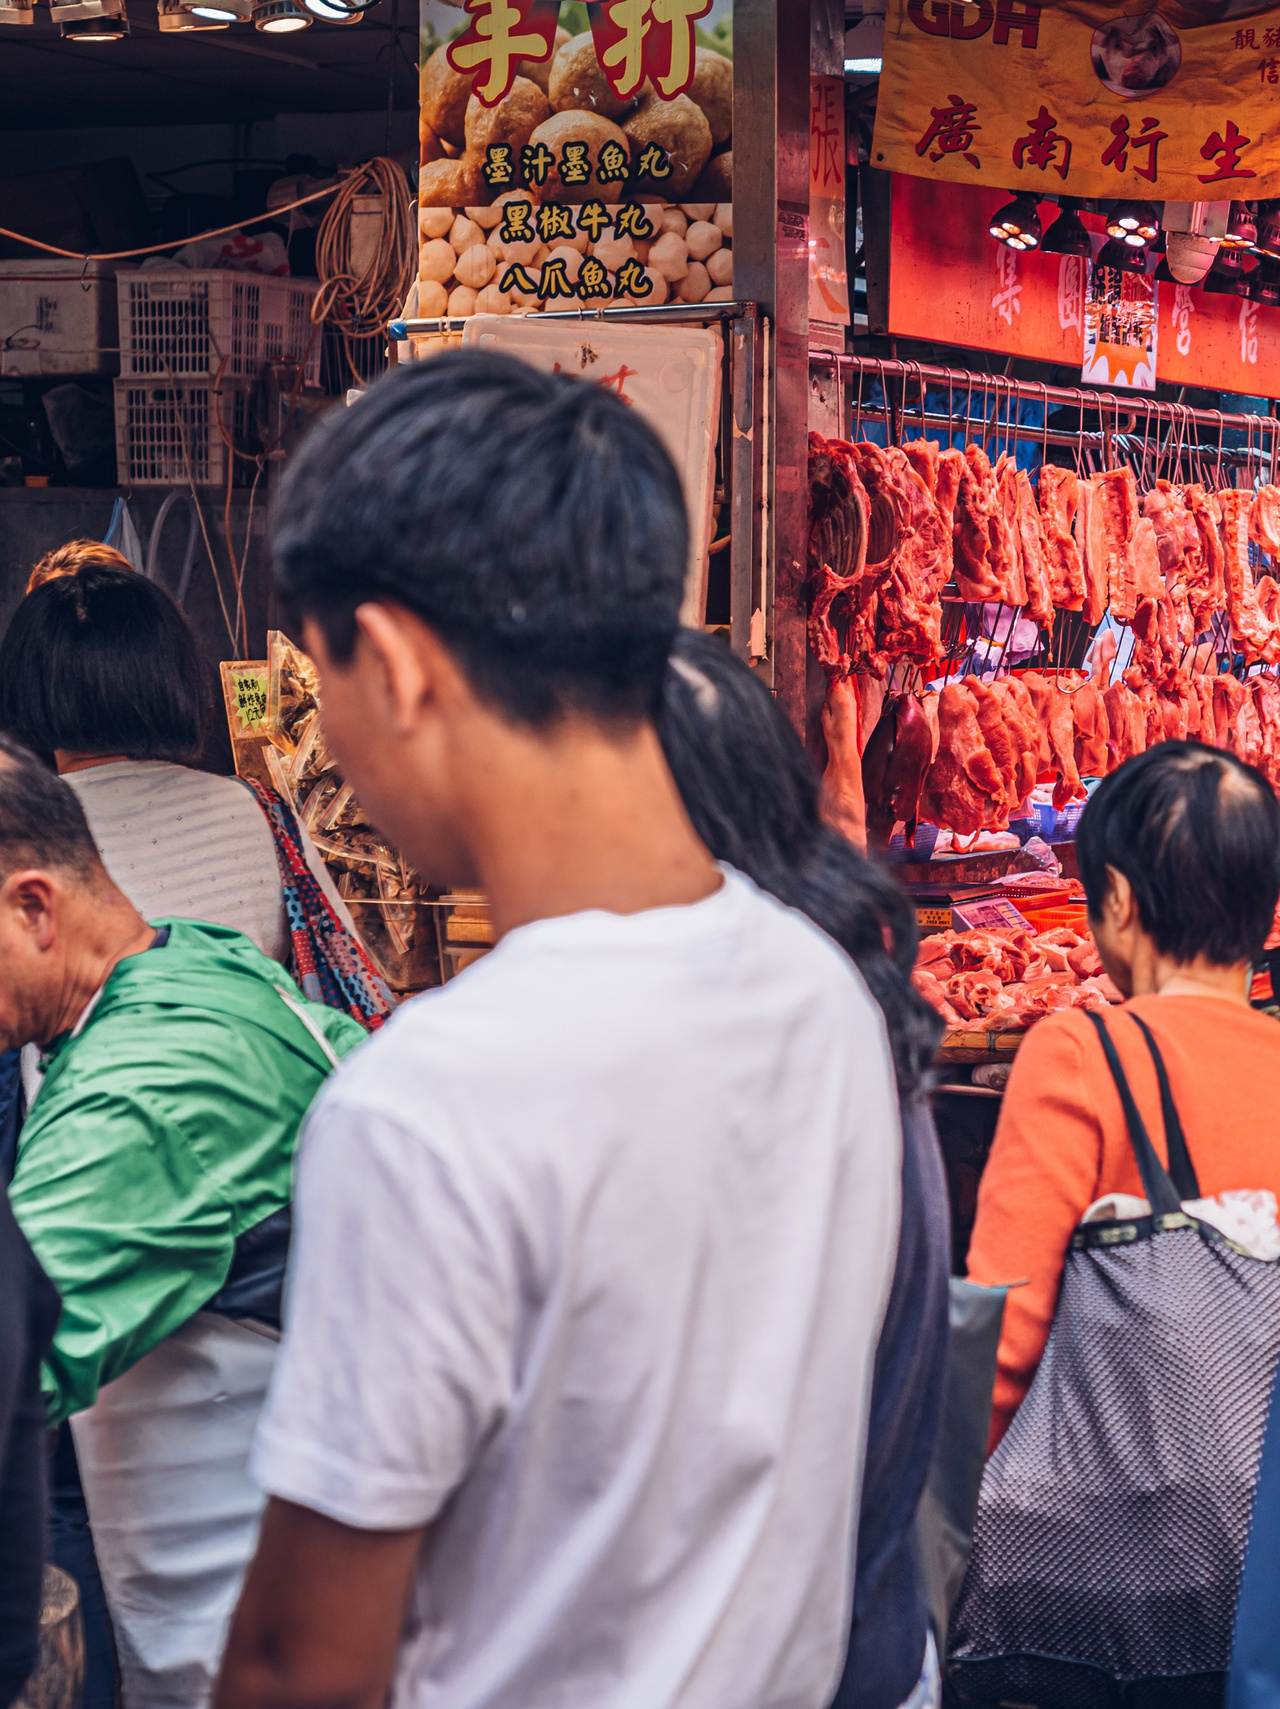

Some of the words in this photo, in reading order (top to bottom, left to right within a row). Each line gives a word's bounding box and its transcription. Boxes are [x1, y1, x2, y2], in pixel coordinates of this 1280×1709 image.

[907, 0, 1041, 49] GDH
[448, 0, 711, 105] 手打
[484, 142, 671, 185] 墨汁墨魚丸
[501, 202, 652, 241] 黑椒牛丸
[501, 259, 652, 297] 八爪魚丸
